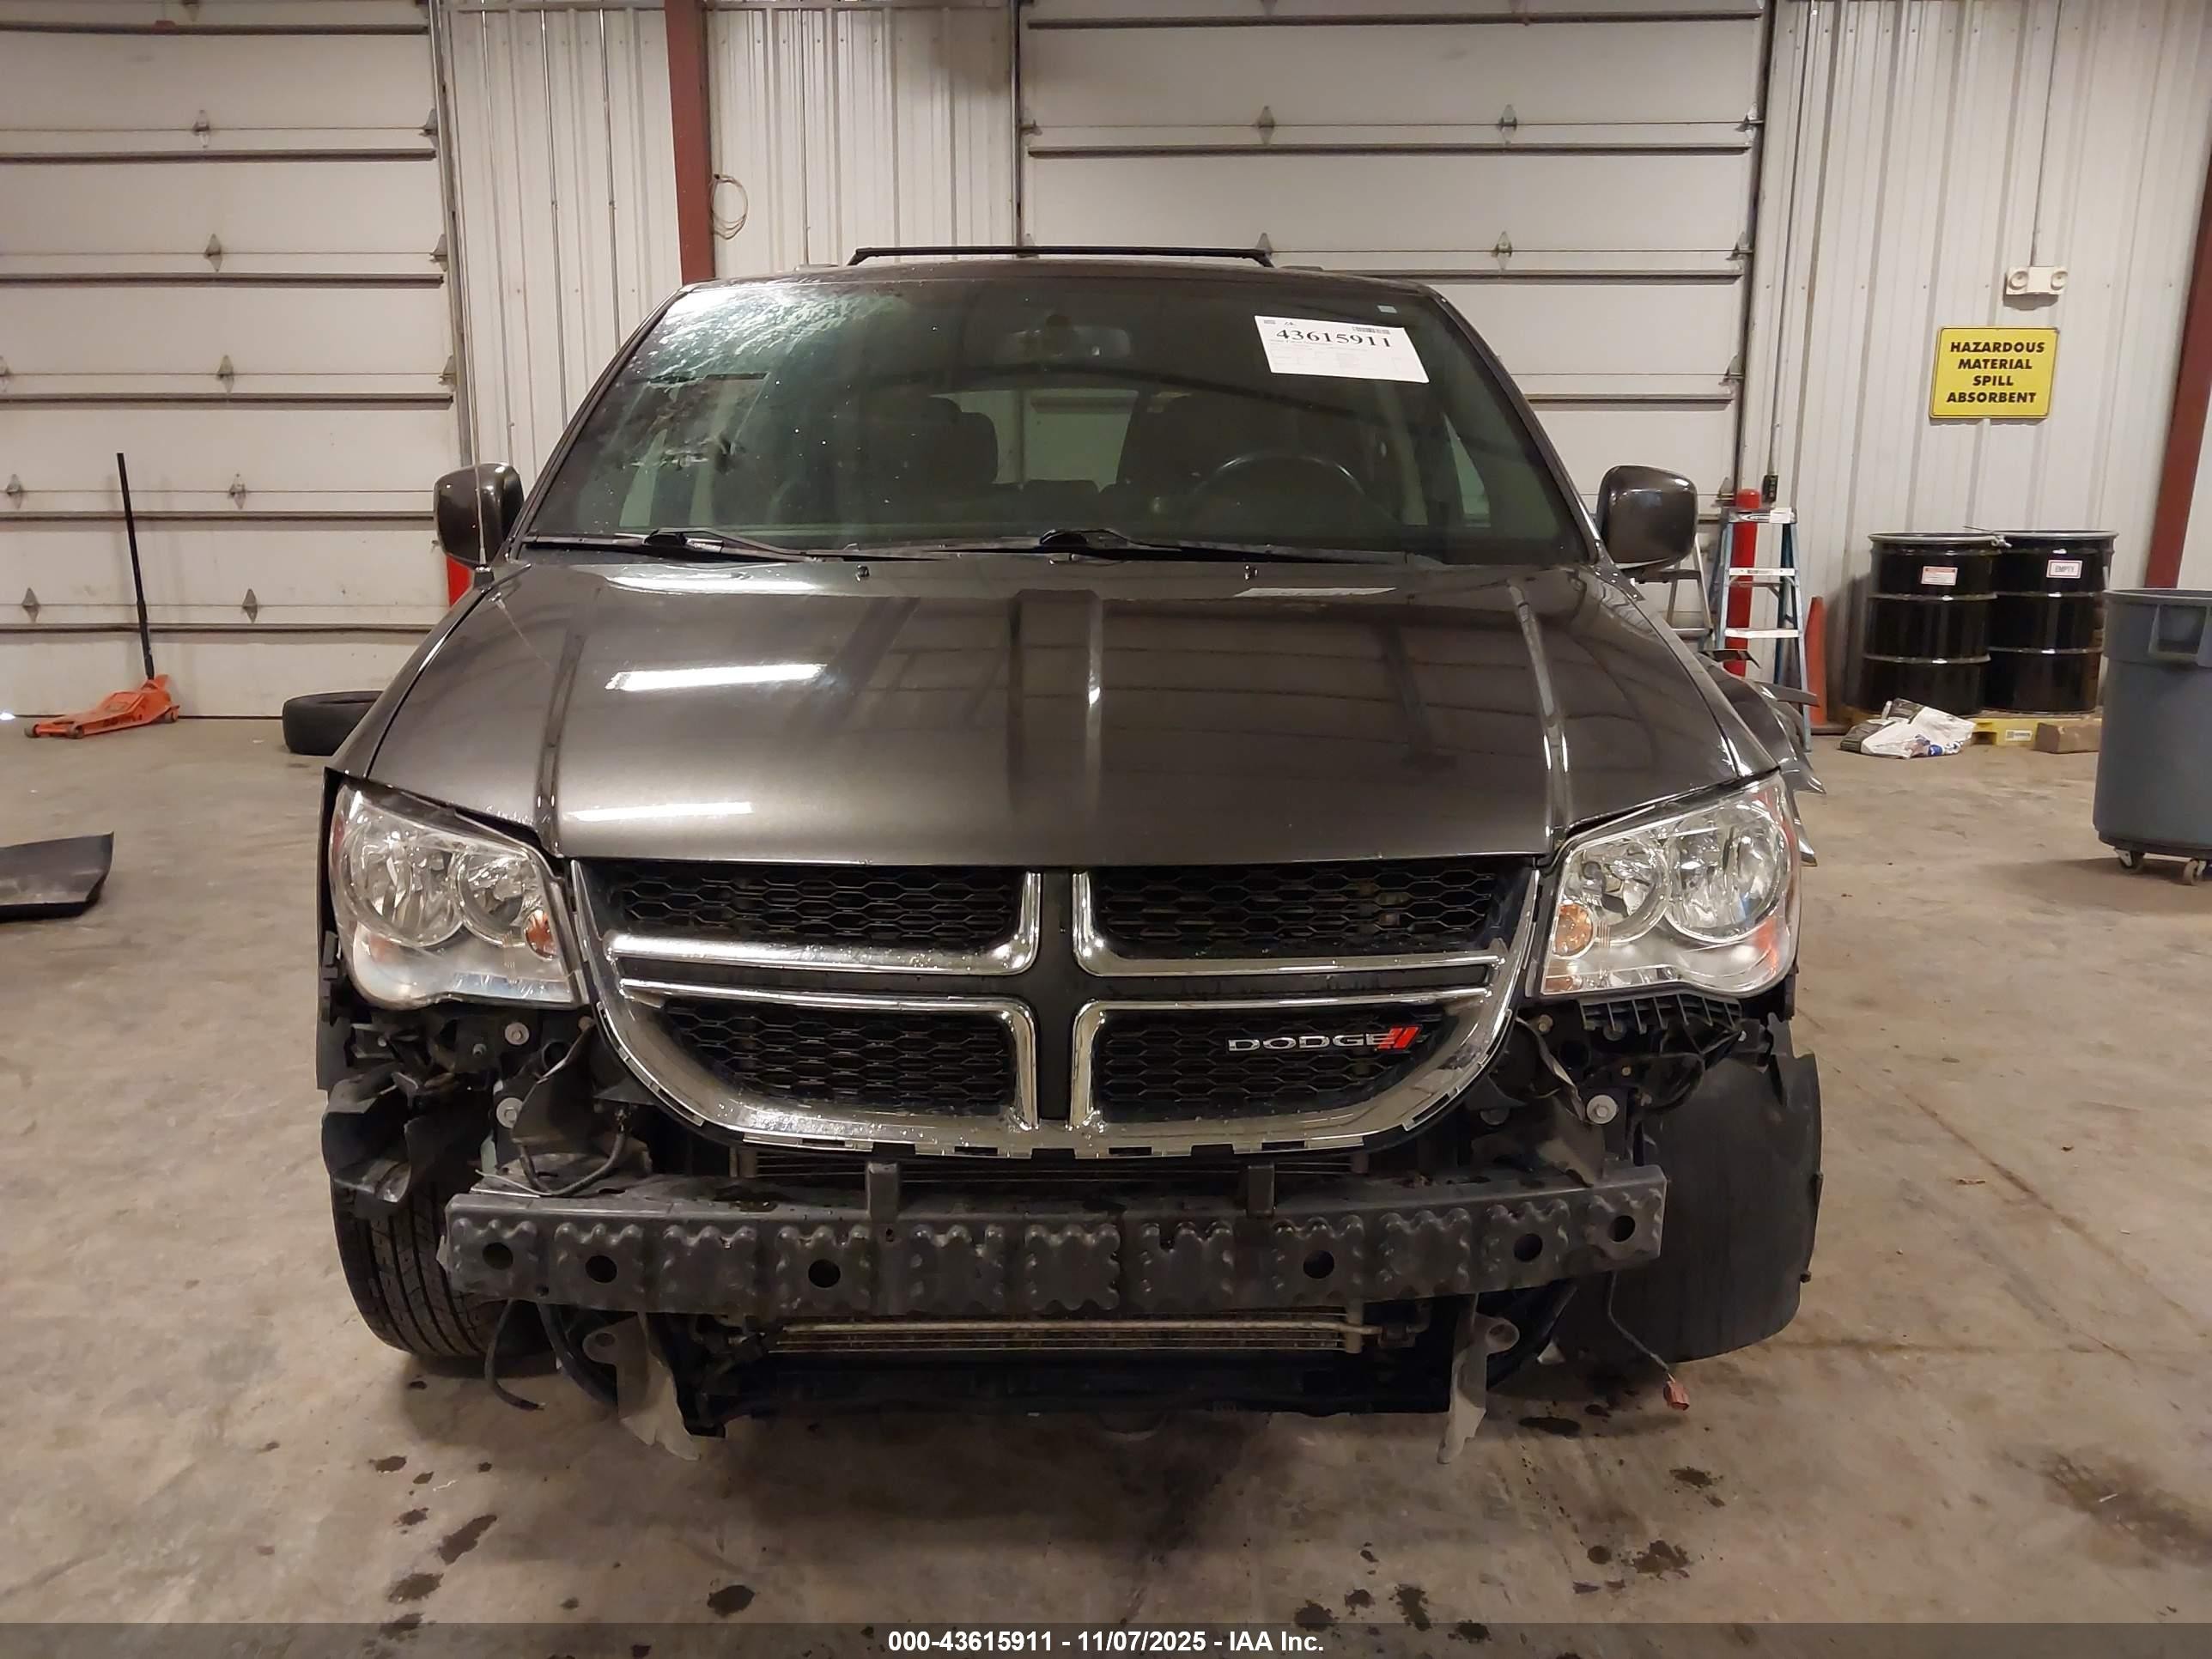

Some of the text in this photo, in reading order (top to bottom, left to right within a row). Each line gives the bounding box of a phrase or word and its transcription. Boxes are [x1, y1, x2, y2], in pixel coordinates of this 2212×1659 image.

[1276, 329, 1391, 348] 43615911
[1950, 342, 2045, 353] HAZARDOUS
[1957, 359, 2033, 370] MATERIAL
[1972, 375, 2014, 386] SPILL
[1946, 392, 2036, 403] ABSORBENT
[1228, 1032, 1395, 1052] DODGE
